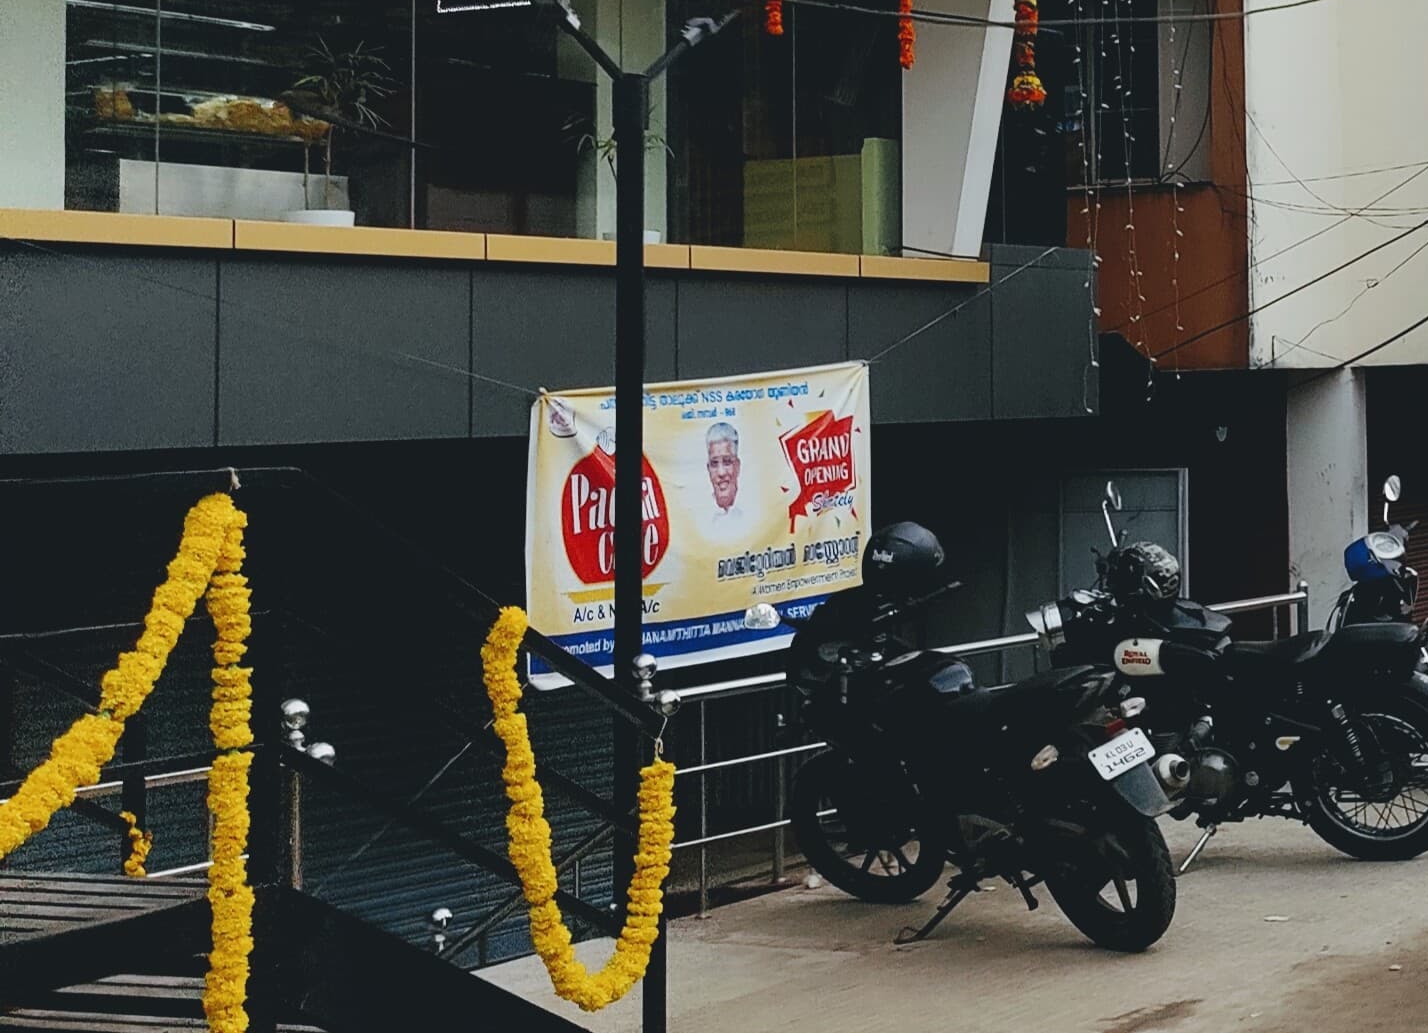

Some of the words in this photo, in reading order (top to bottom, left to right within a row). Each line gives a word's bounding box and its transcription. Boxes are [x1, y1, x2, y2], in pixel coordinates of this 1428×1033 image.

[797, 432, 850, 464] GRAND
[804, 462, 849, 486] OPENING
[571, 473, 661, 535] Paa
[573, 605, 594, 624] A/c
[597, 604, 605, 620] &
[603, 638, 615, 653] by
